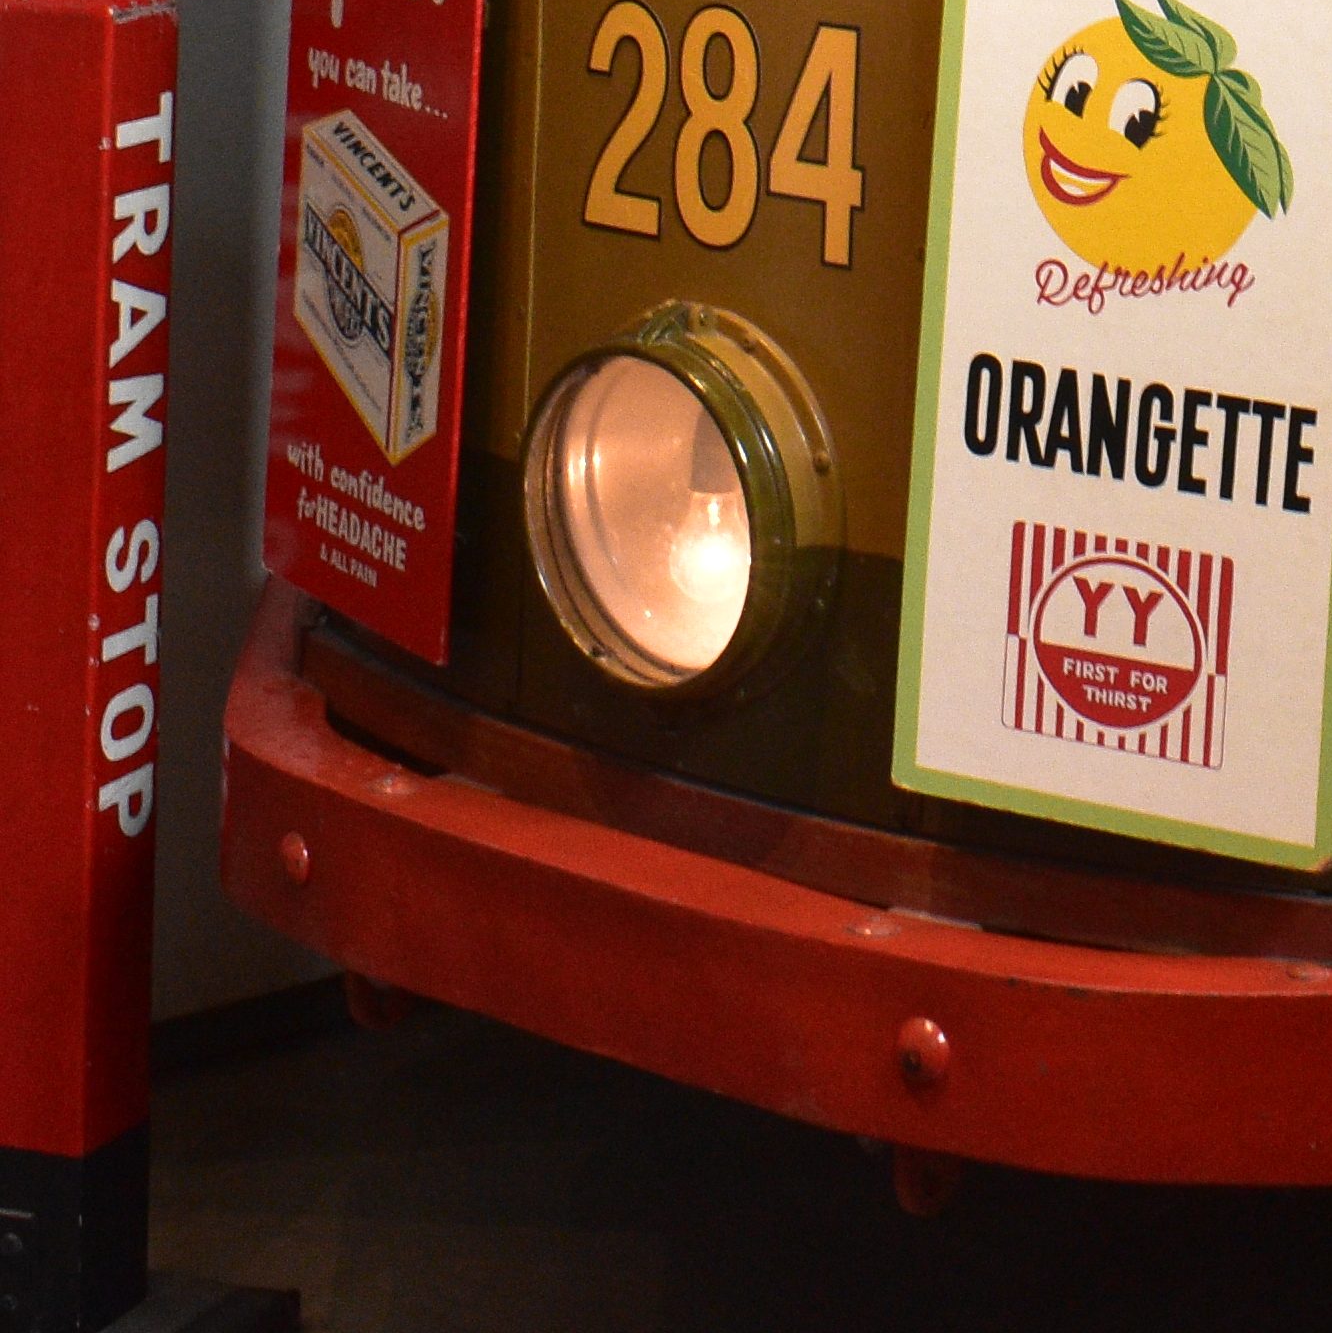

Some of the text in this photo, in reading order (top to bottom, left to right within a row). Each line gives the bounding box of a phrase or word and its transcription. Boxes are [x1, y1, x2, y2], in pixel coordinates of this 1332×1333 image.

[307, 47, 339, 89] you
[345, 58, 377, 95] can
[1035, 251, 1256, 316] Refreshing
[98, 90, 173, 840] TRAM STOP
[964, 351, 1317, 515] ORANGETTE
[286, 440, 426, 532] with confidence
[316, 493, 407, 572] HEADACHE
[330, 548, 348, 573] ALL
[350, 557, 378, 589] PAIN
[1062, 655, 1170, 698] FIRST FOR
[1082, 683, 1153, 716] THIRST
